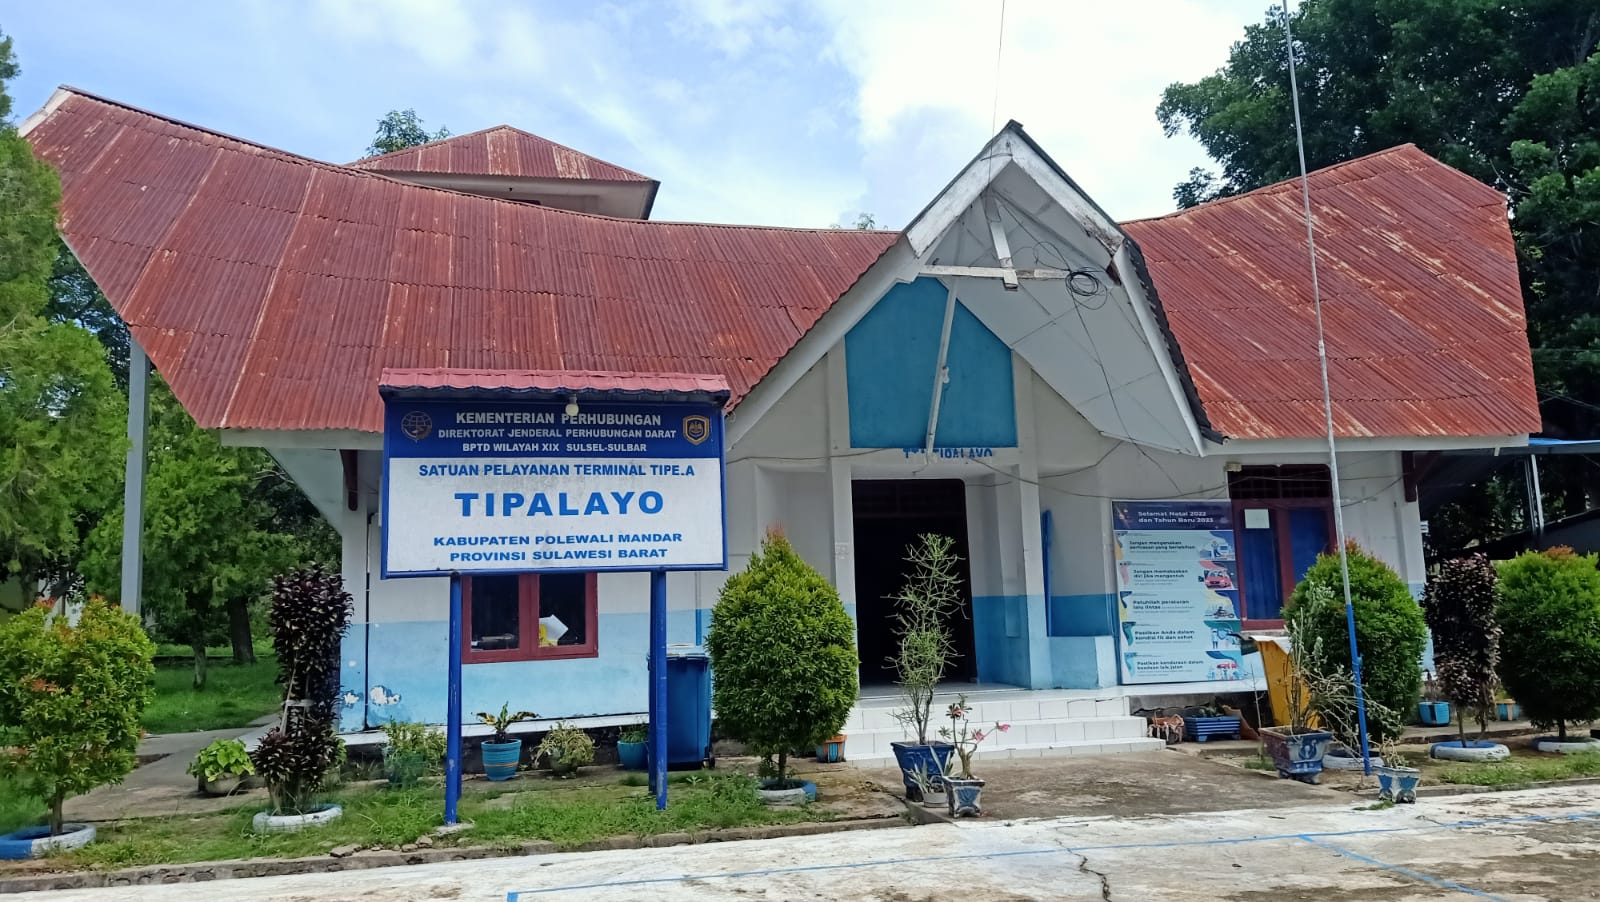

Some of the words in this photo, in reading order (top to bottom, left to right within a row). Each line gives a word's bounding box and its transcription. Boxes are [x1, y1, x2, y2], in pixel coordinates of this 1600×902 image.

[456, 412, 555, 425] KEMENTERIAN
[561, 413, 661, 426] PERHUBUNGAN
[438, 429, 505, 439] DIREKTORAT
[507, 429, 562, 438] JENDERAL
[565, 428, 643, 438] PERHUBUNGAN
[645, 428, 676, 439] DARAT
[462, 443, 491, 452] BPTD
[493, 443, 539, 452] WILAYAH
[541, 443, 559, 452] XIX
[566, 443, 647, 452] SULSEL-SULBAR
[418, 464, 479, 477] SATUAN
[483, 464, 570, 476] PELAYANAN
[575, 464, 646, 476] TERMINAL
[651, 464, 695, 476] TIPE.A
[454, 491, 664, 517] TIPALAYO
[433, 535, 530, 546] KABUPATEN
[535, 534, 613, 545] POLEWALI
[618, 533, 682, 543] MANDAR
[450, 550, 526, 562] PROVINSI
[532, 549, 612, 561] SULAWESI
[618, 548, 668, 559] BARAT
